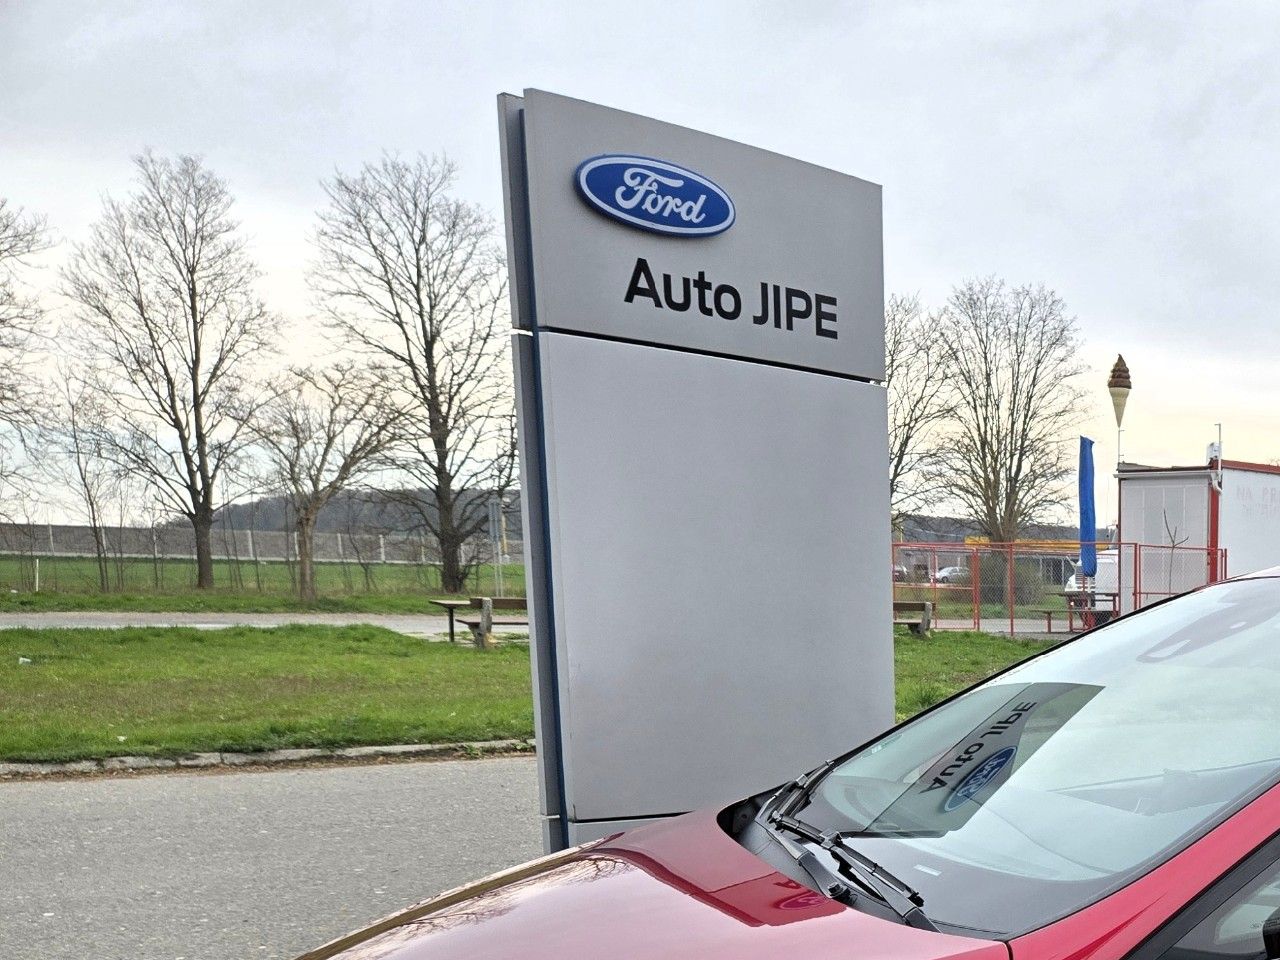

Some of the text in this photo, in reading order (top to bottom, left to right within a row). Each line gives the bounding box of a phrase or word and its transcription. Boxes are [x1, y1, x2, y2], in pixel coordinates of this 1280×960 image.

[614, 166, 707, 224] Ford
[623, 257, 838, 340] Auto JIPE
